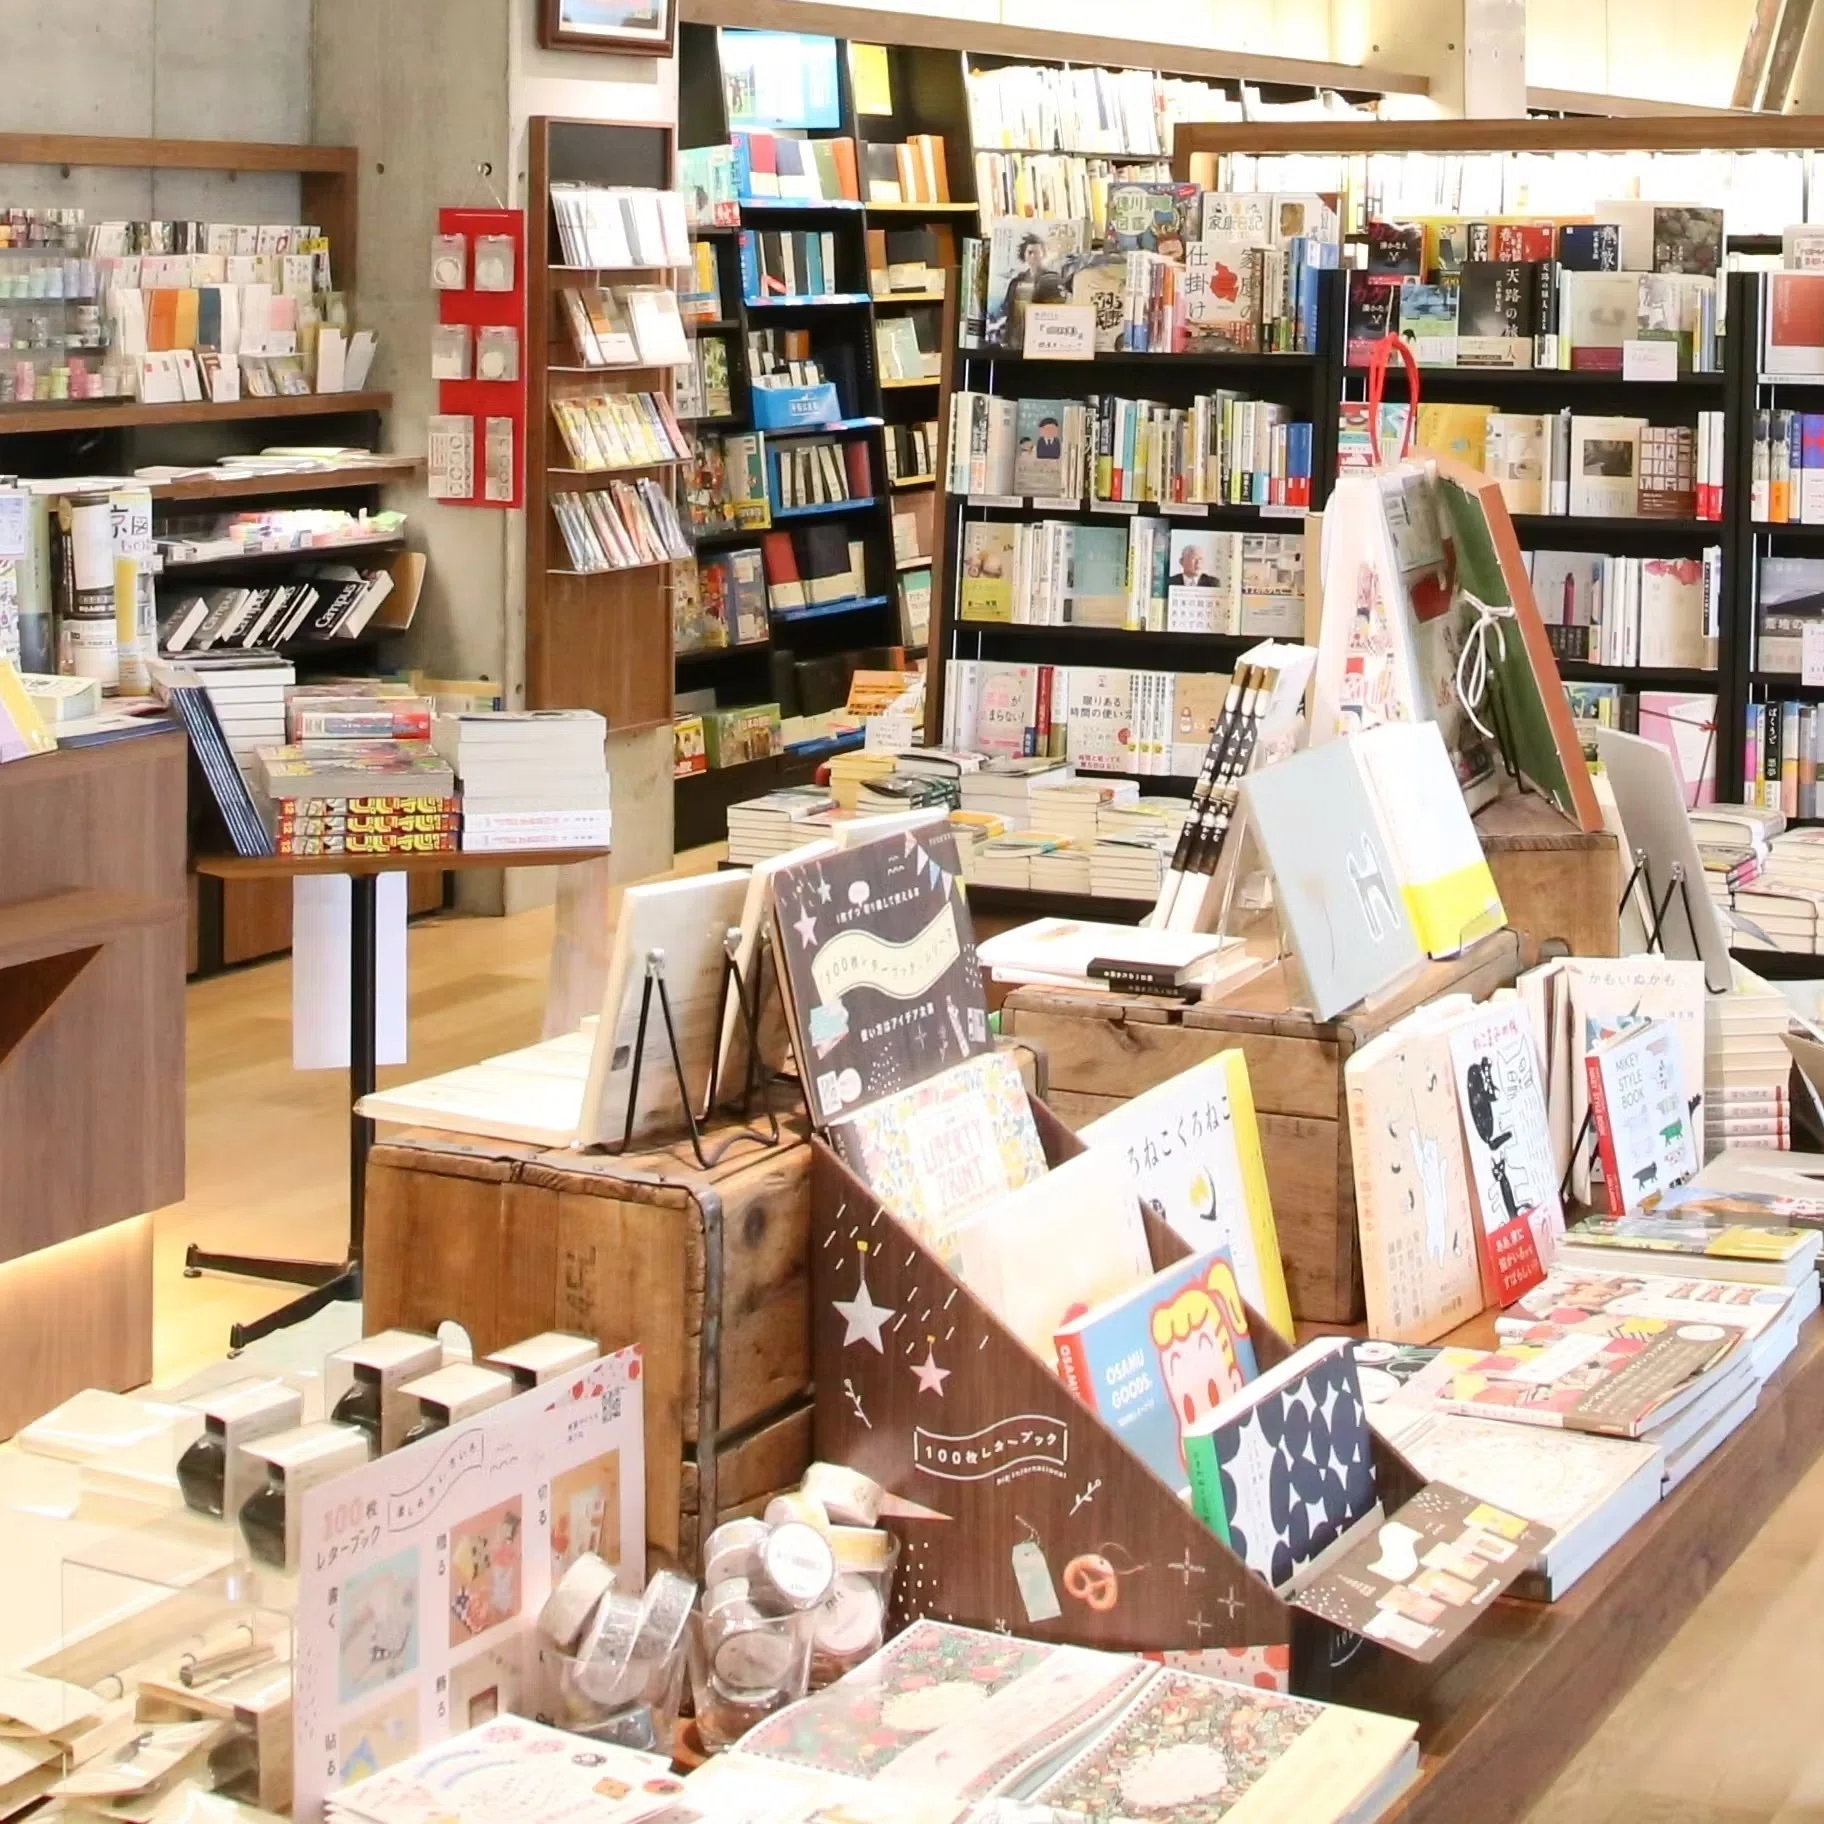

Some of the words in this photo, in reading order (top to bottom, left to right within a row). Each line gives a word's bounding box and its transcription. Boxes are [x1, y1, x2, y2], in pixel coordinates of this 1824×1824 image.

[314, 583, 358, 628] Campus
[1082, 695, 1122, 707] 限りある
[1069, 707, 1133, 721] 時間の使い方
[1589, 972, 1676, 988] かもいぬかも
[1615, 1053, 1640, 1072] MIKEY
[1618, 1072, 1643, 1093] STYLE
[1621, 1090, 1645, 1110] BOOK
[1104, 1347, 1145, 1386] OSAMU
[925, 1430, 1058, 1466] 100枚レターブック
[315, 1524, 381, 1573] レターブック
